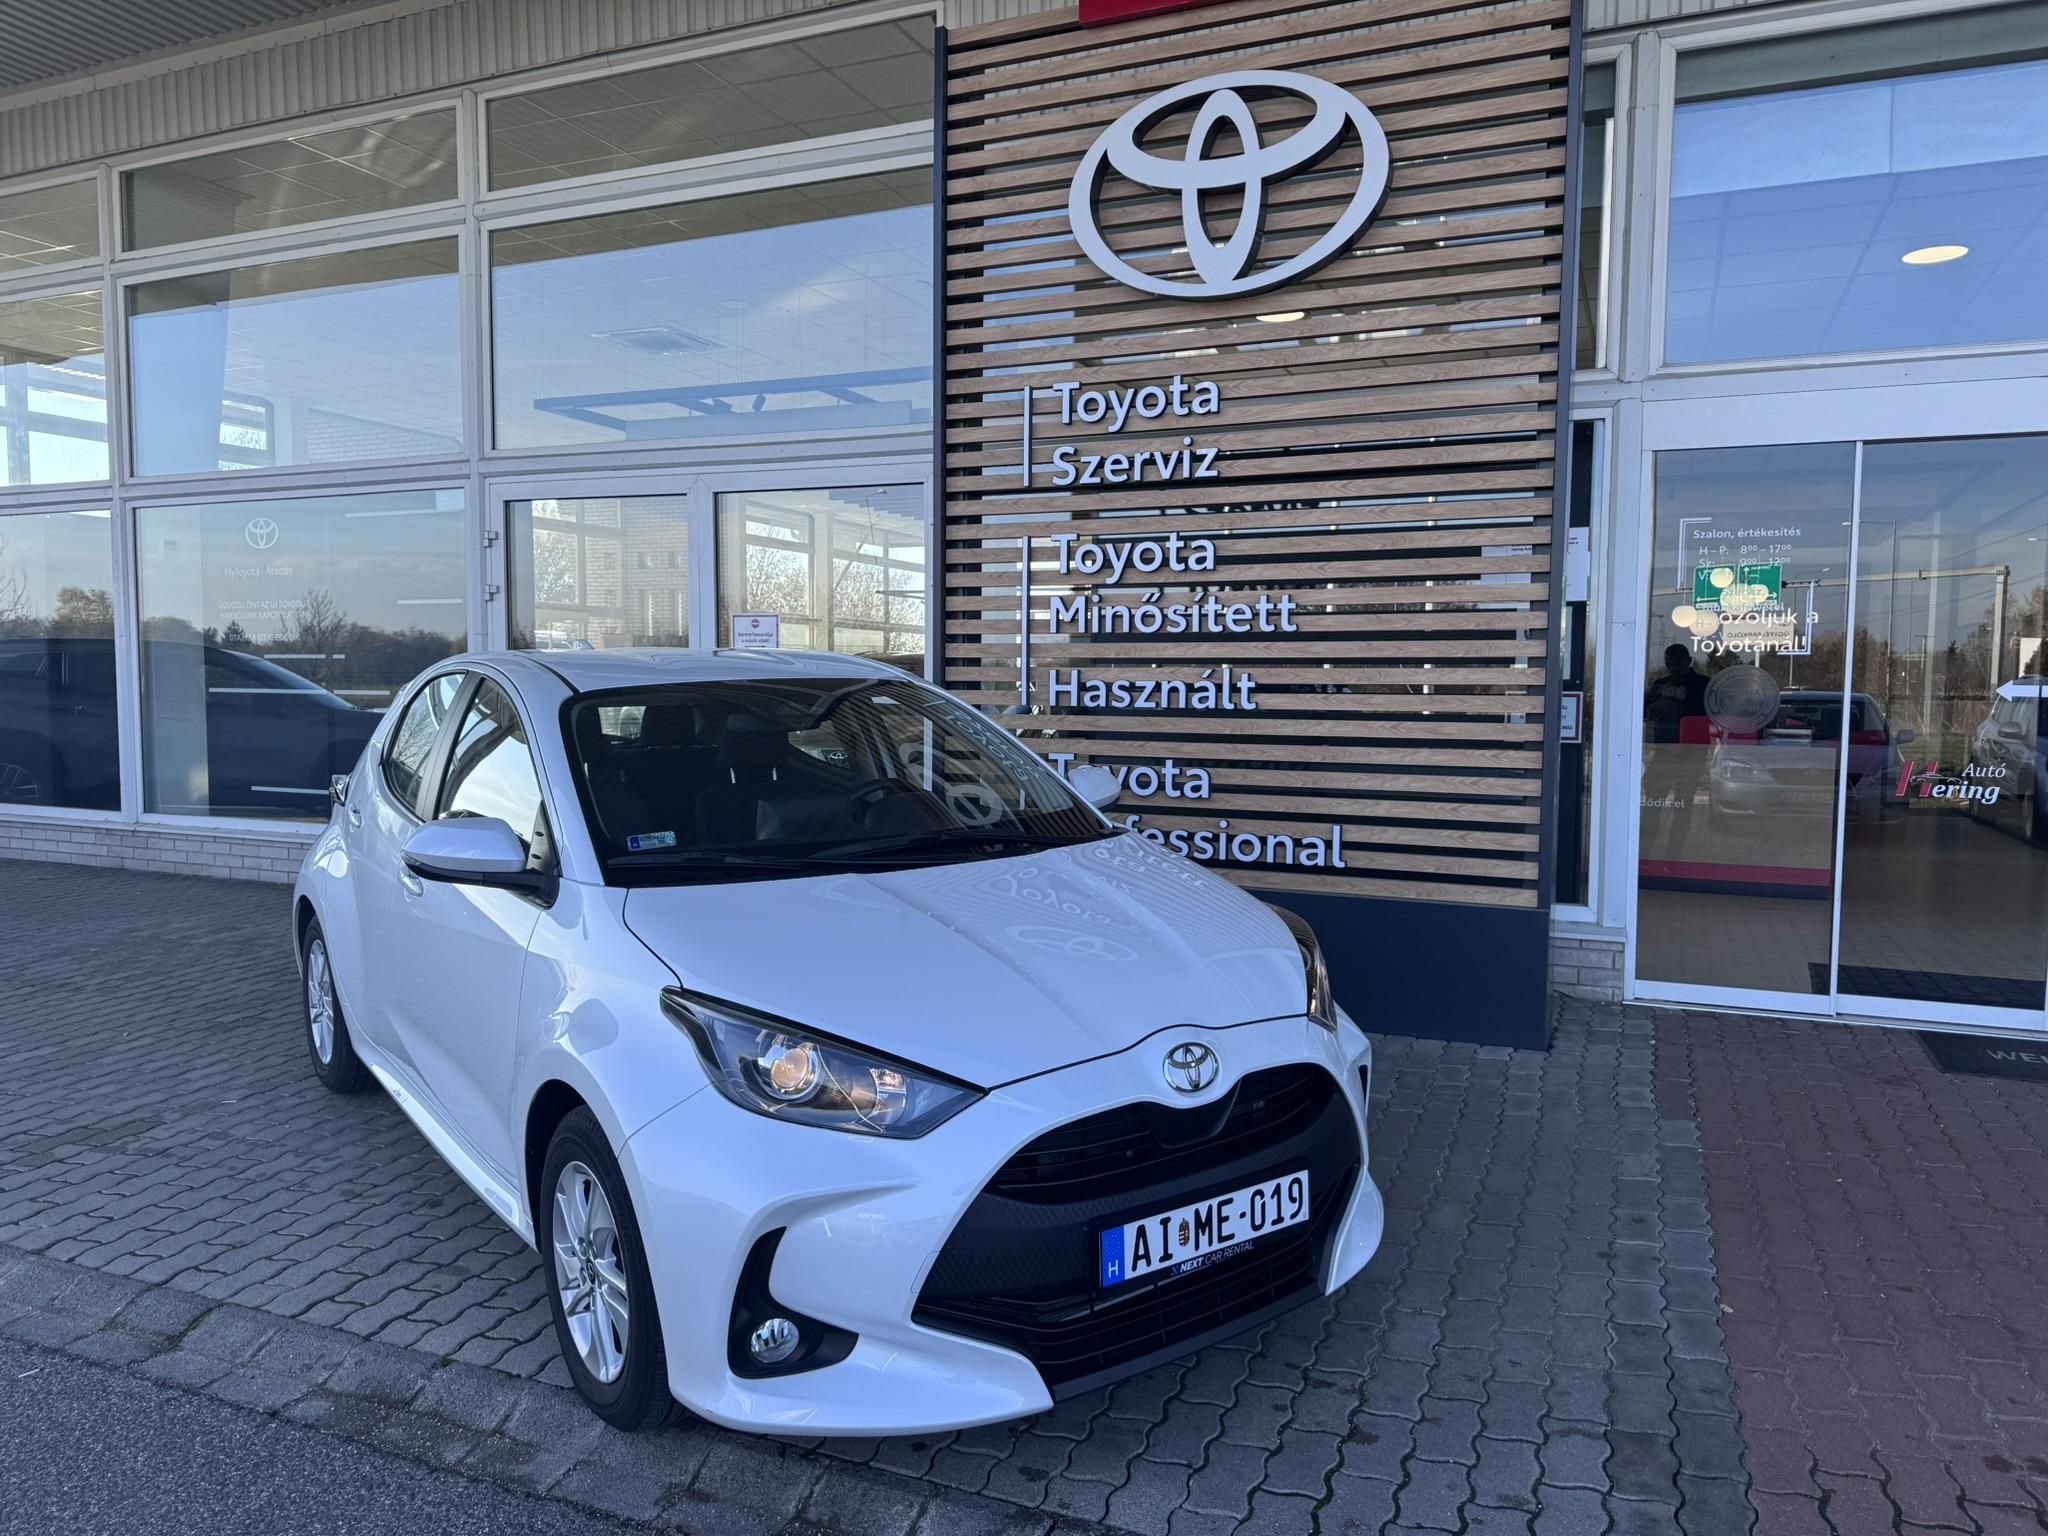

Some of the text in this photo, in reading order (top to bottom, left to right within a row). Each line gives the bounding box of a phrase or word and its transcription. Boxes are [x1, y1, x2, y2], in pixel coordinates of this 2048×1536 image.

[1052, 374, 1219, 432] Toyota
[1052, 436, 1219, 486] Szerviz
[1693, 526, 1802, 540] Szalon, értékesítés
[1051, 532, 1216, 585] Toyota
[1049, 592, 1298, 634] Minősített
[1049, 667, 1257, 710] Használt
[1895, 760, 2000, 805] Hering
[1961, 763, 2007, 778] Autó
[1126, 814, 1347, 868] fessional
[1986, 1050, 2048, 1064] WE
[1131, 1216, 1174, 1272] AI
[1180, 1241, 1255, 1273] NEXT CAR RENTAL
[1108, 1259, 1119, 1279] H
